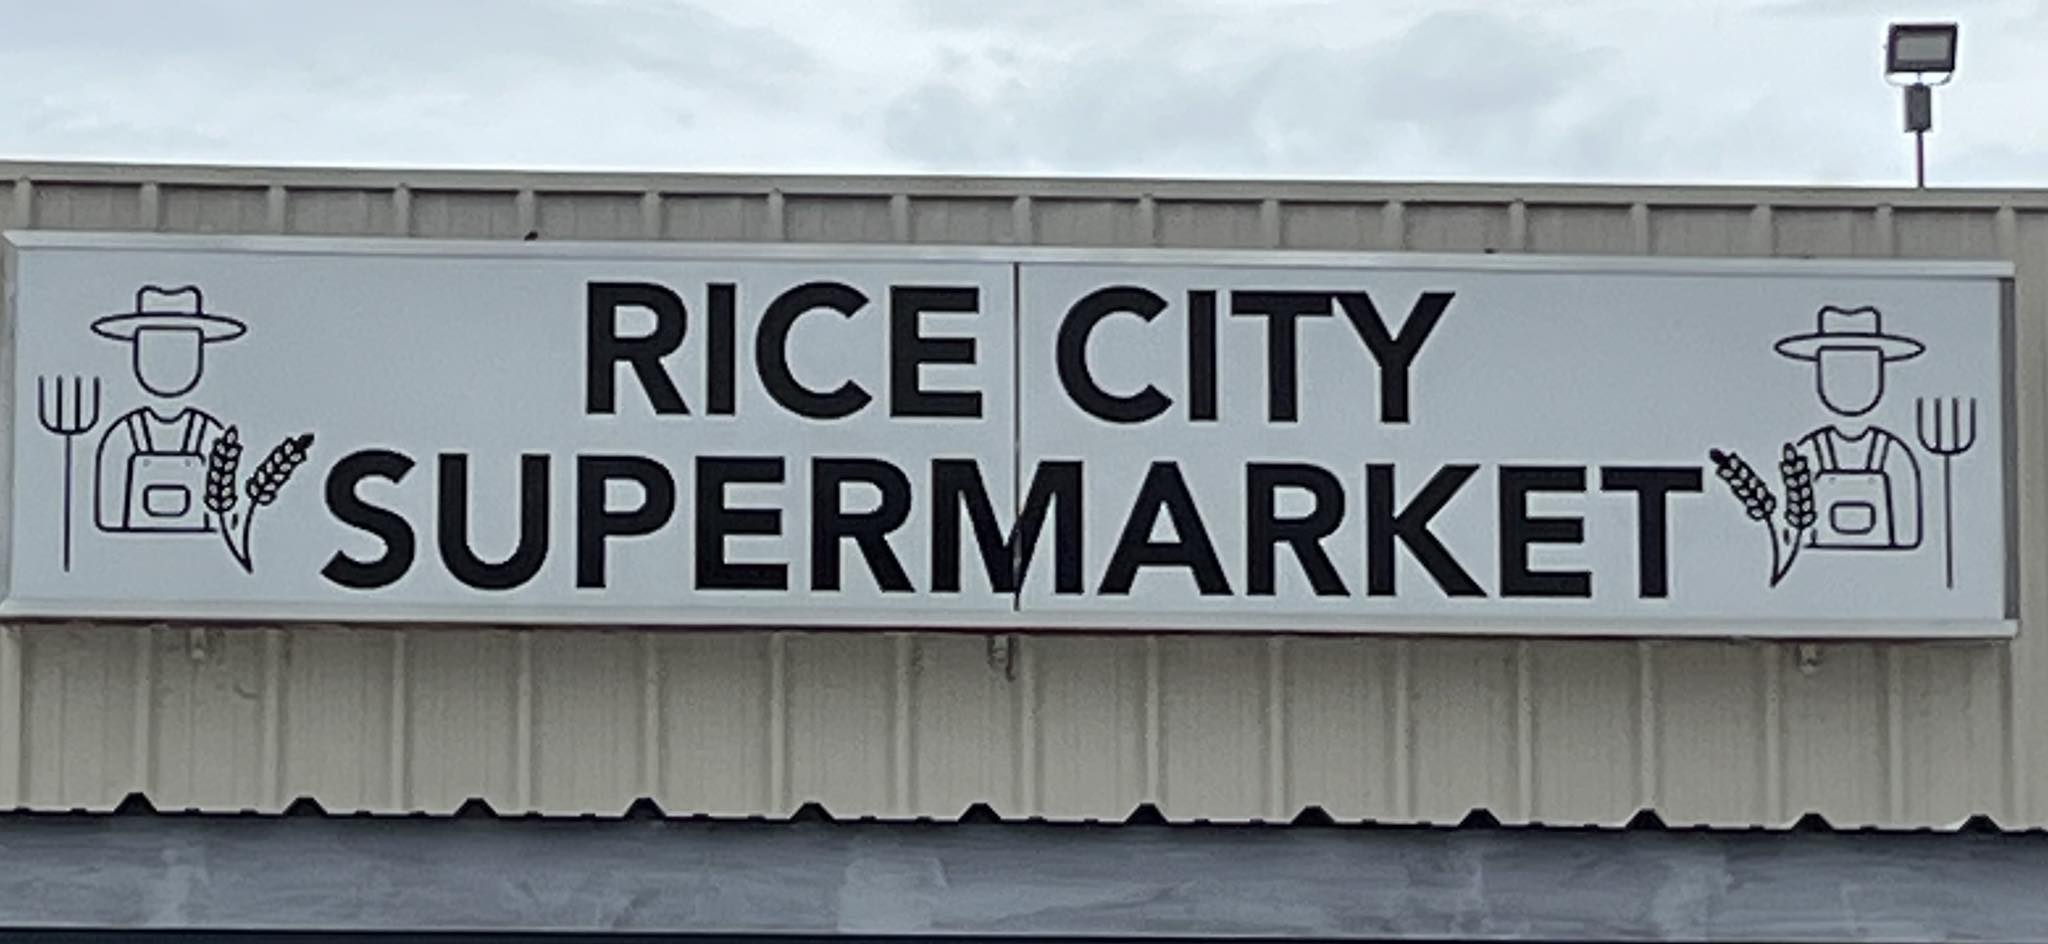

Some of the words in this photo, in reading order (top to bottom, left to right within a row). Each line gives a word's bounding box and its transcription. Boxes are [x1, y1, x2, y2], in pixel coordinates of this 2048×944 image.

[585, 281, 983, 420] RICE
[1056, 285, 1456, 424] CITY
[320, 449, 1704, 600] SUPERMARKET
